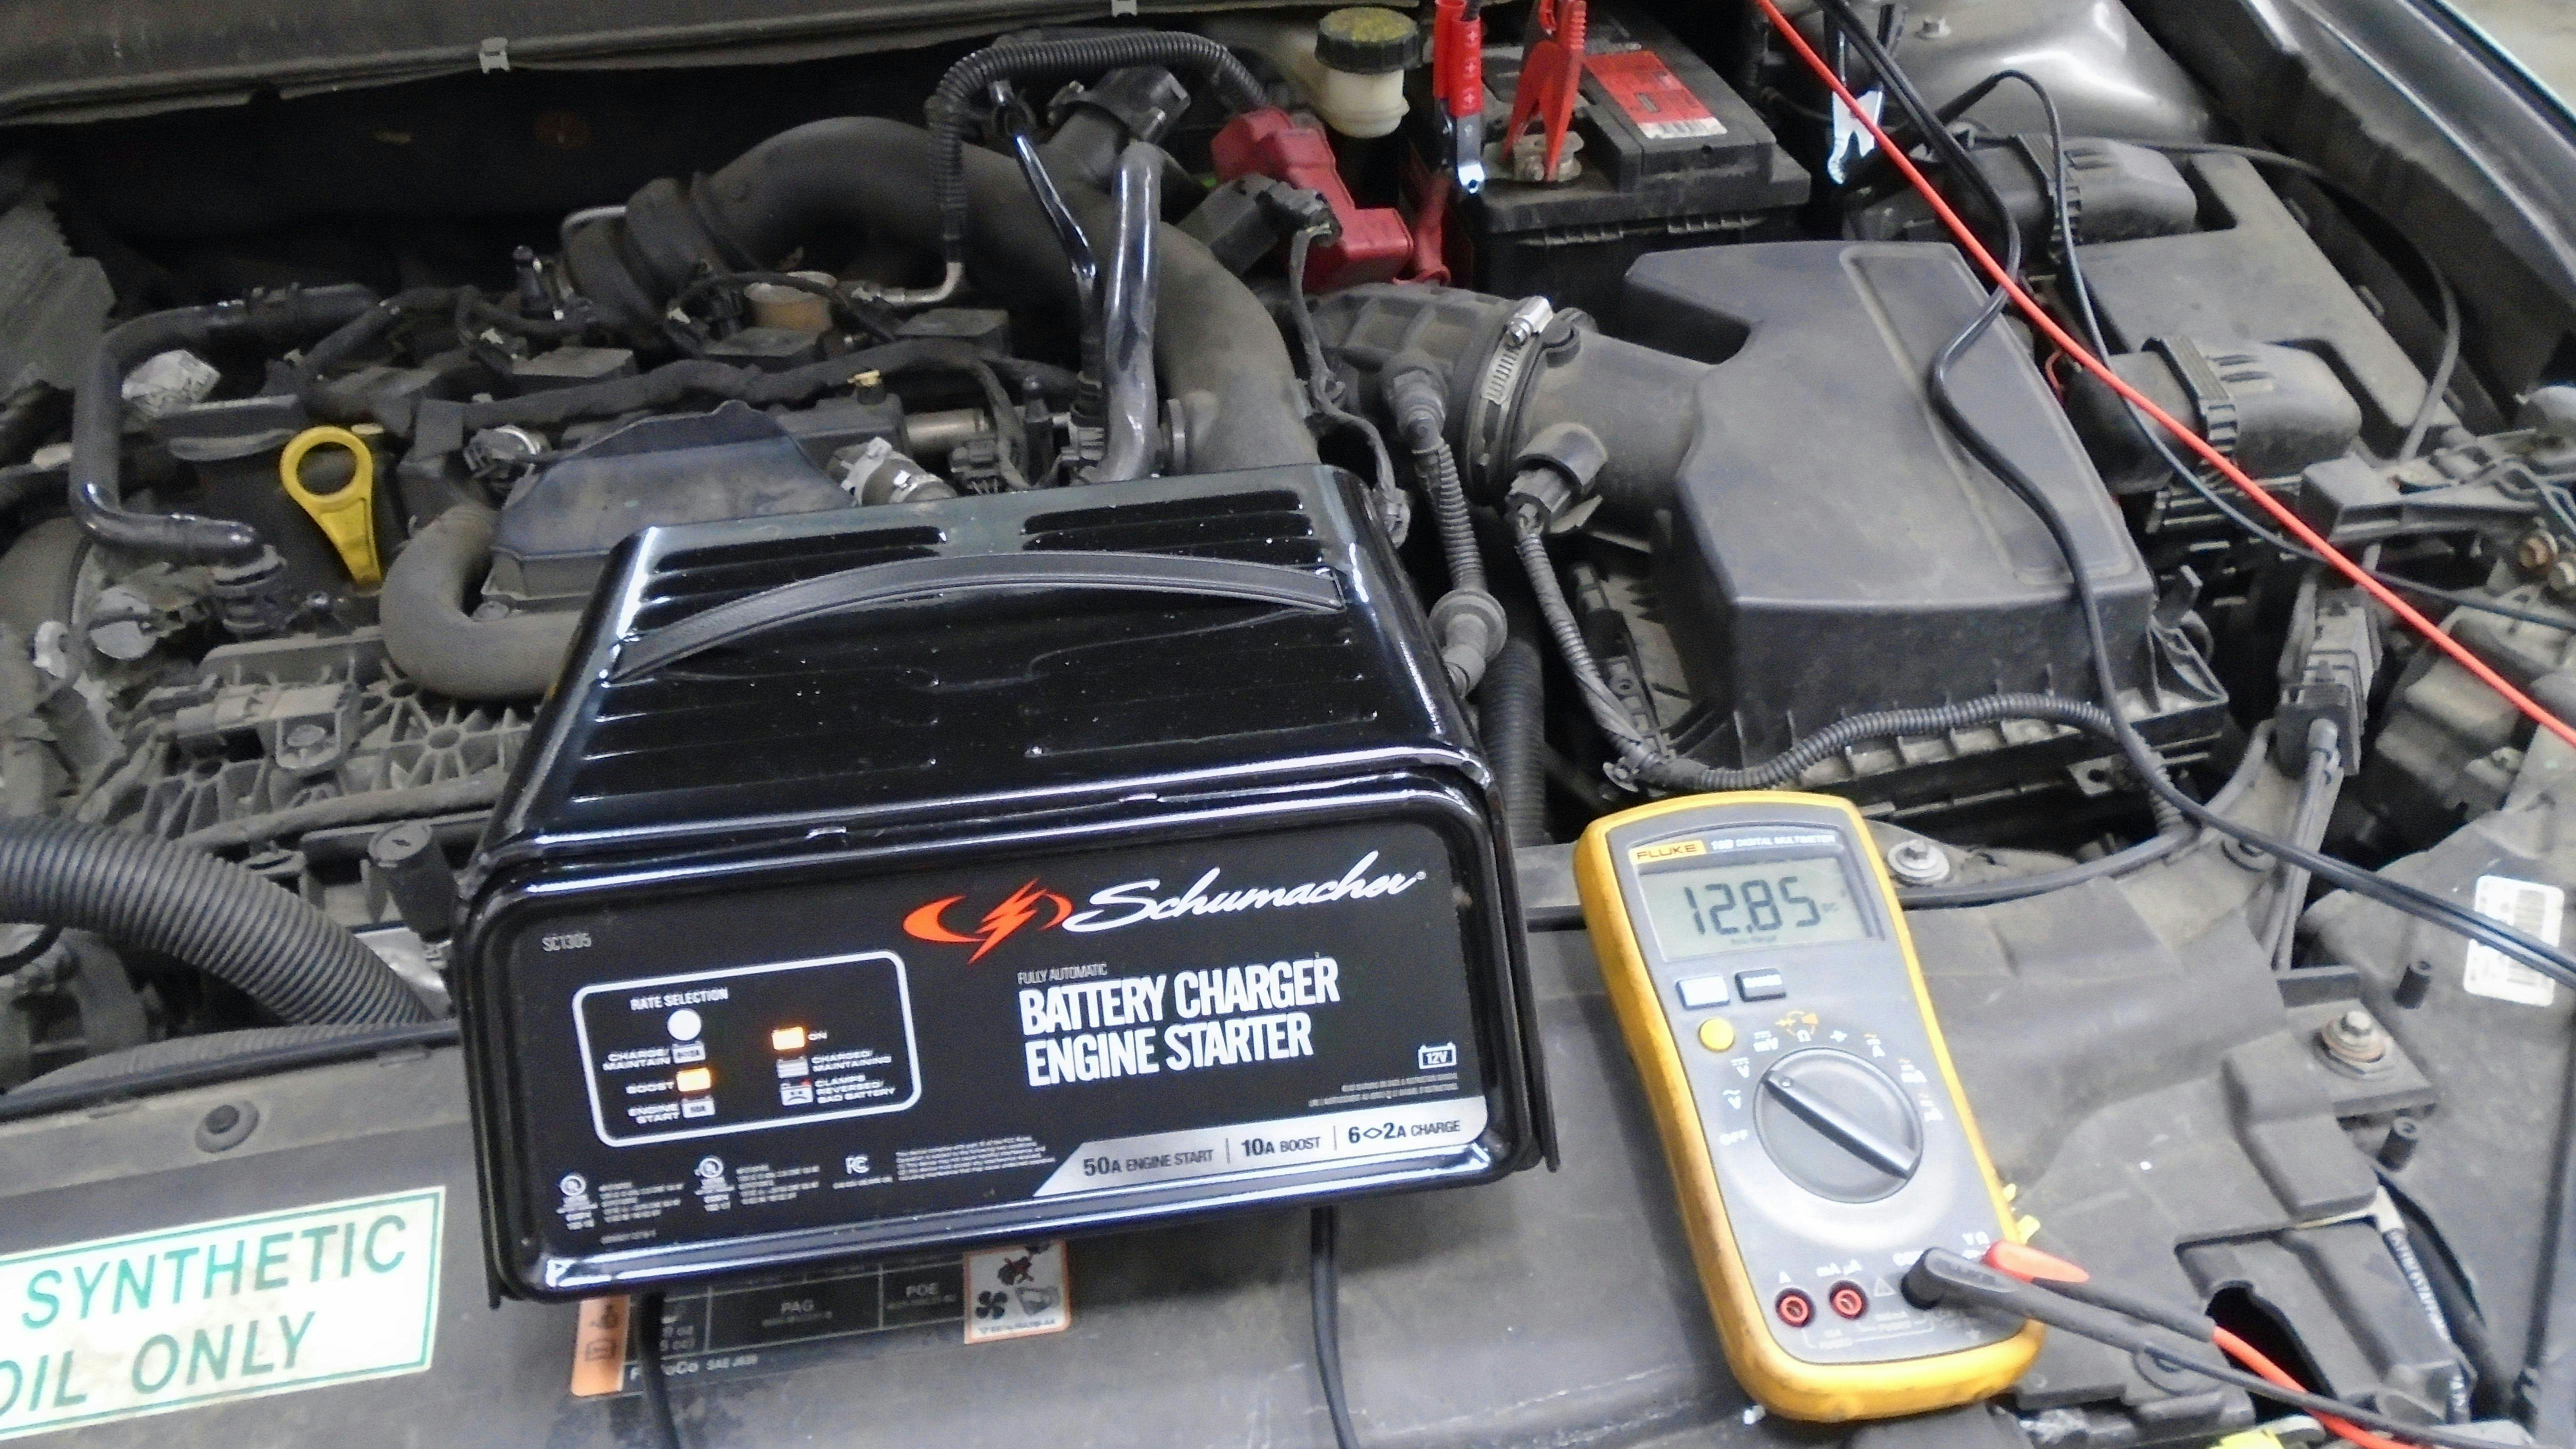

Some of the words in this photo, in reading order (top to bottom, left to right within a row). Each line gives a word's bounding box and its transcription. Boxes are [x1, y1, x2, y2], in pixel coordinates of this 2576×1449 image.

[1637, 844, 1698, 860] FLUKE
[1736, 837, 1773, 847] DIGITAL
[1774, 835, 1836, 845] MULTIMETER
[1683, 876, 1820, 935] 12.85
[1016, 969, 1047, 985] FULLY
[1048, 962, 1108, 982] AUTOMATIC
[630, 995, 664, 1010] RATE
[663, 987, 729, 1006] SELECTION
[1018, 974, 1167, 1036] BATTERY
[1174, 956, 1341, 1019] CHARGER
[808, 1031, 828, 1041] ON
[1025, 1026, 1160, 1086] ENGINE
[1164, 1010, 1314, 1071] STARTER
[1426, 1050, 1448, 1064] 12V
[626, 1080, 675, 1094] BOOST
[628, 1102, 680, 1117] ENGINE
[636, 1112, 680, 1124] START
[1084, 1156, 1122, 1176] 50A
[1126, 1154, 1172, 1172] ENGINE
[1174, 1149, 1214, 1166] START
[1242, 1138, 1276, 1157] 10A
[1280, 1136, 1321, 1152] BOOST
[1410, 1120, 1460, 1136] CHARGE
[21, 1214, 406, 1329] SYNTHETIC
[131, 1311, 316, 1394] ONLY
